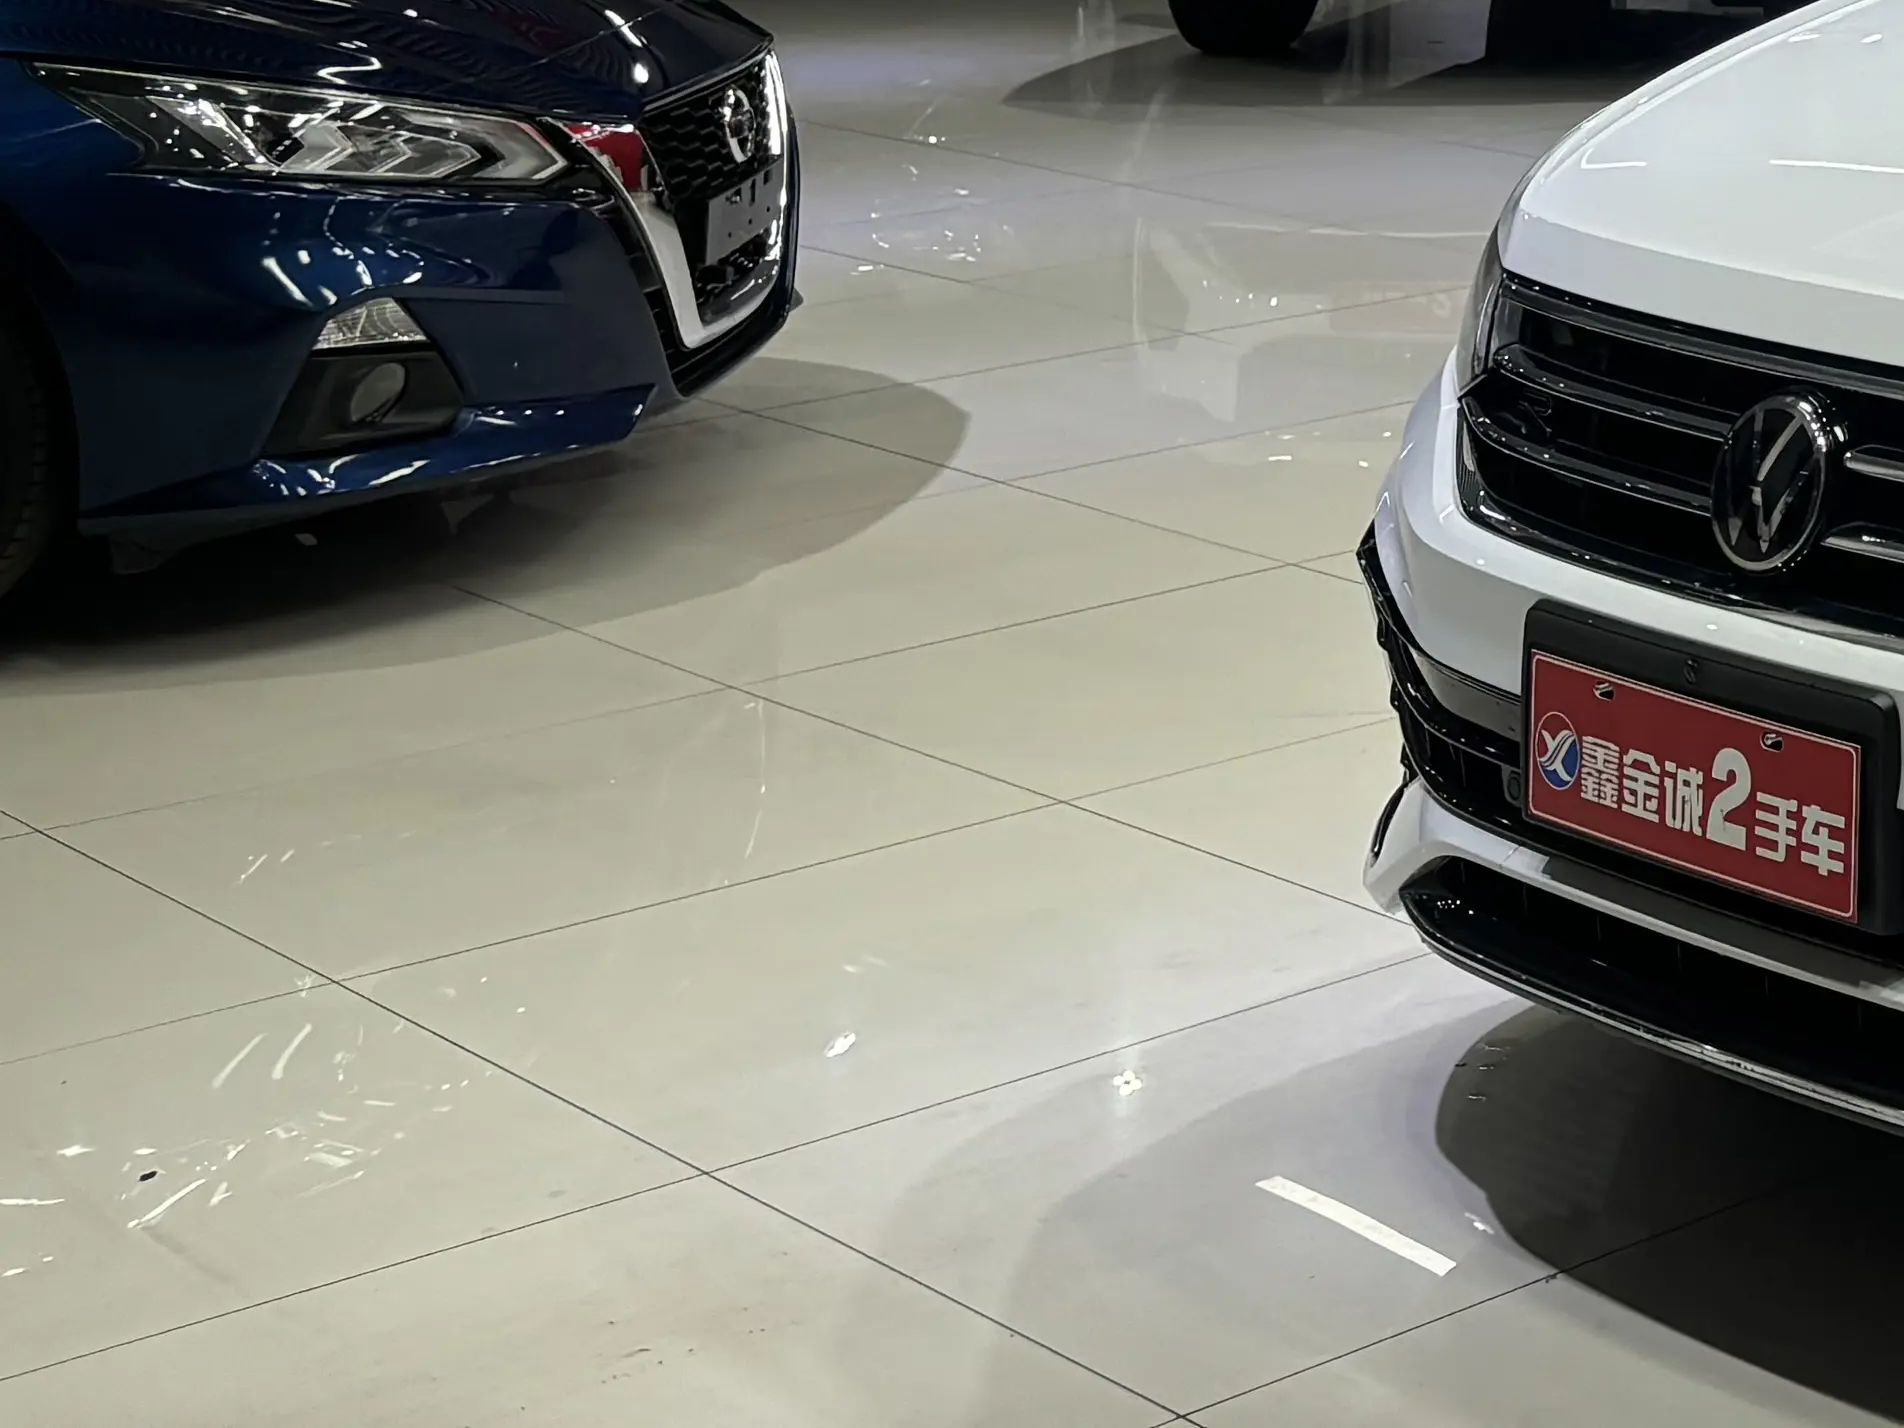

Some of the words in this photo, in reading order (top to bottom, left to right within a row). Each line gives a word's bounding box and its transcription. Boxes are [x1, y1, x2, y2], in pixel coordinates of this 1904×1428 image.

[1580, 735, 1846, 877] 鑫金诚2手车
